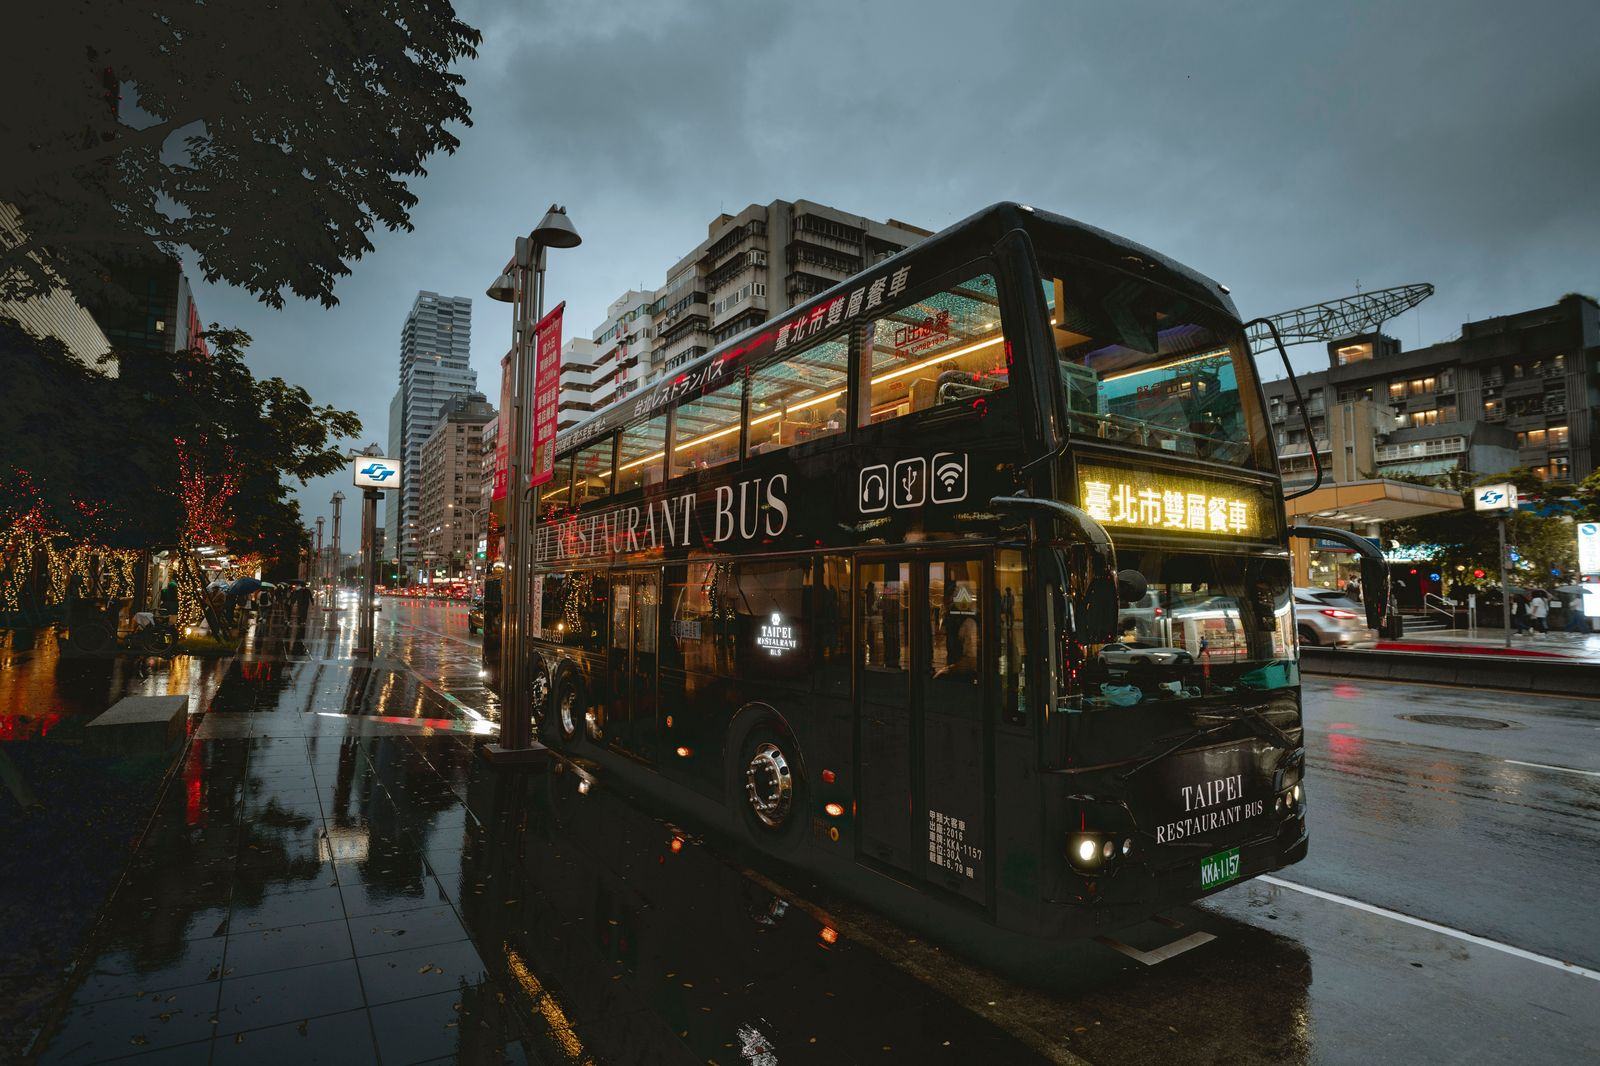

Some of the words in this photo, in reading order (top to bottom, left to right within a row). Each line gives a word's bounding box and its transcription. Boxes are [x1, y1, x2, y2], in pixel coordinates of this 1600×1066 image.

[774, 265, 911, 351] 臺北市雙層餐車
[634, 359, 724, 417] 台北レストランバス
[556, 493, 696, 560] RESTAURANT
[713, 474, 788, 542] BUS
[1084, 481, 1248, 533] 臺北市雙層餐車
[757, 636, 797, 648] RESTAURANT
[761, 625, 792, 639] TAIPEI
[1181, 774, 1243, 812] TAIPEI
[1156, 805, 1242, 844] RESTAURANT
[1245, 800, 1263, 819] BUS
[1201, 854, 1240, 885] KKA-1157
